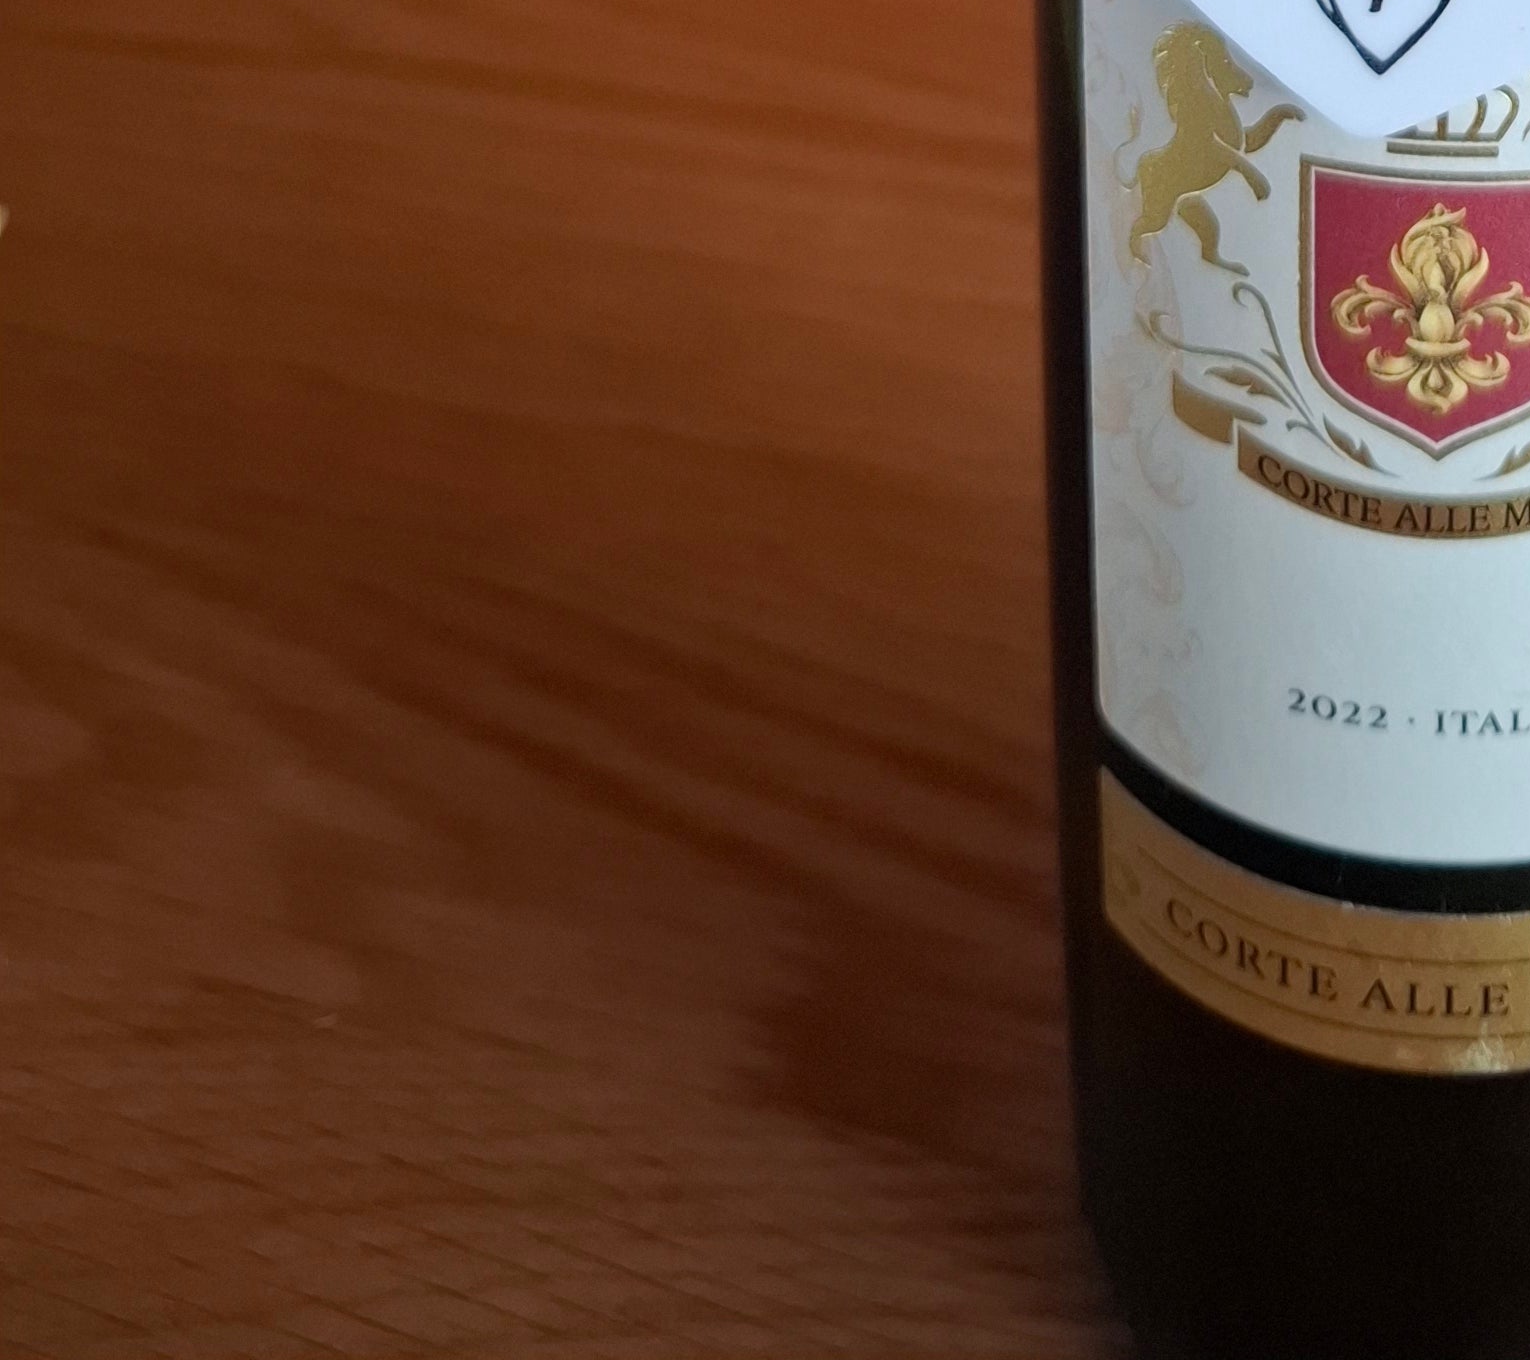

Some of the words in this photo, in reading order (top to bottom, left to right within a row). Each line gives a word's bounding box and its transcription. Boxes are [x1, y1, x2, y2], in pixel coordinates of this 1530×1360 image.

[1256, 453, 1383, 525] CORTE
[1393, 504, 1491, 534] ALLE
[1288, 687, 1388, 729] 2022
[1166, 898, 1338, 1003] CORTE
[1361, 978, 1510, 1018] ALLE
